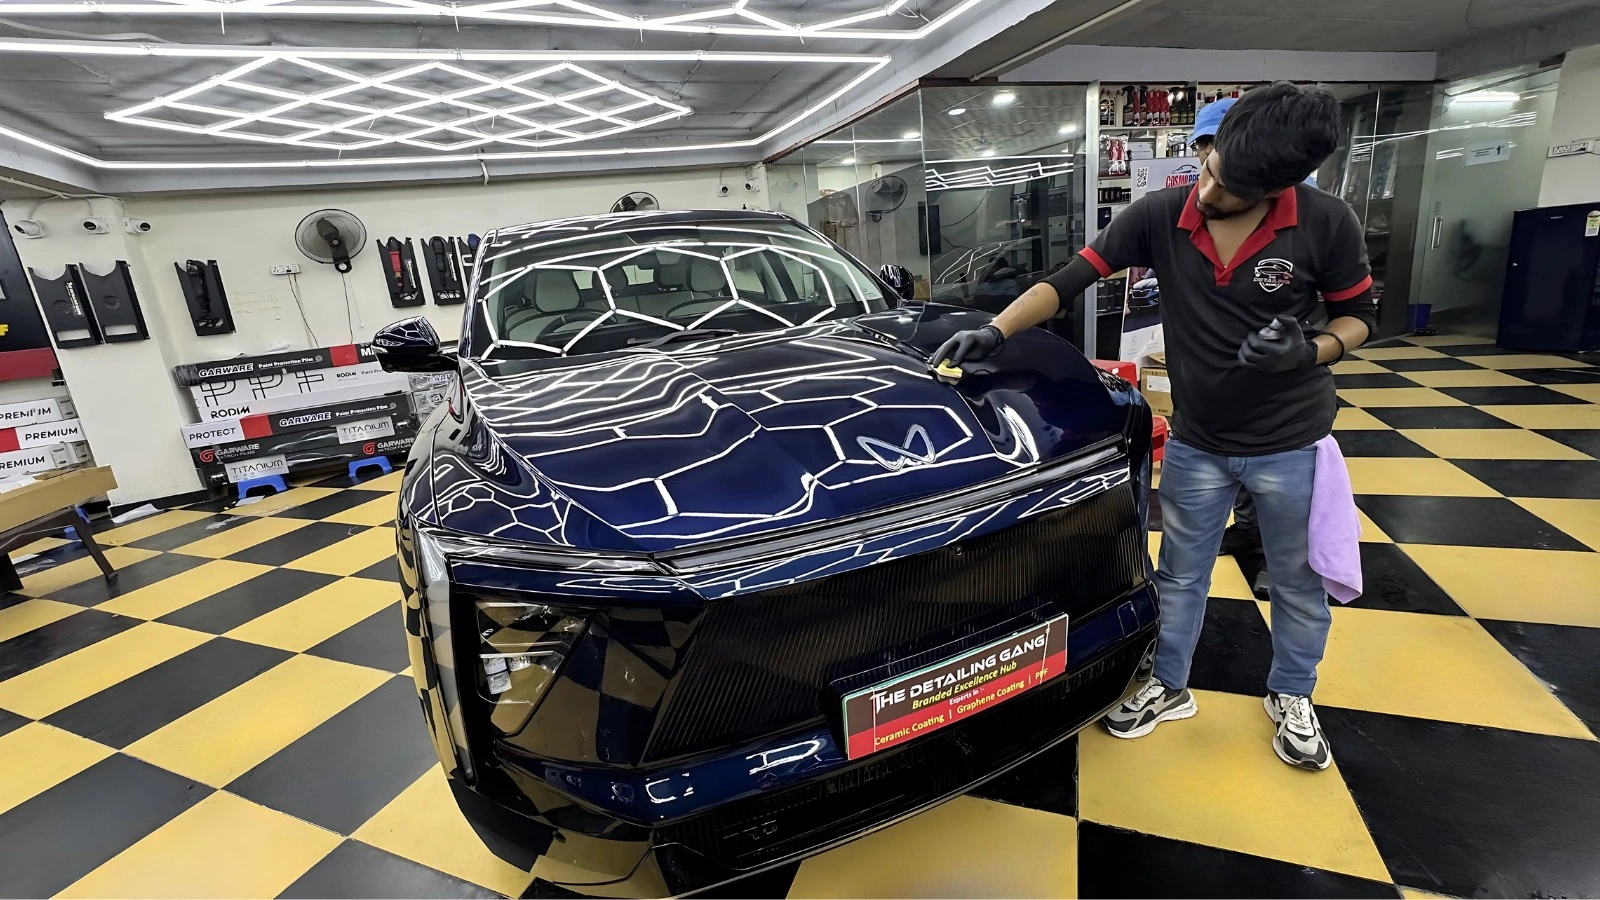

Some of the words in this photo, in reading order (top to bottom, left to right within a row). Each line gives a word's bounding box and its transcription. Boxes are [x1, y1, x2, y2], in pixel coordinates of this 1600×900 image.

[199, 363, 254, 377] GARWARE
[210, 406, 251, 419] RODIM
[279, 412, 331, 427] GARWARE
[25, 427, 78, 441] PREMIUM
[189, 427, 236, 441] PROTECT
[341, 421, 390, 435] TITANIUM
[216, 443, 260, 456] GARWARE
[231, 460, 283, 474] TITANIUM
[869, 690, 906, 714] THE
[910, 654, 997, 698] DETAILING
[1000, 634, 1045, 661] GANG
[912, 687, 953, 710] Branded
[954, 669, 998, 694] Excellence
[1000, 661, 1017, 675] Hub
[949, 691, 972, 706] Experts
[875, 727, 910, 746] Ceramic
[912, 714, 945, 732] Coating
[957, 693, 996, 714] Graphene
[996, 680, 1025, 697] Coating
